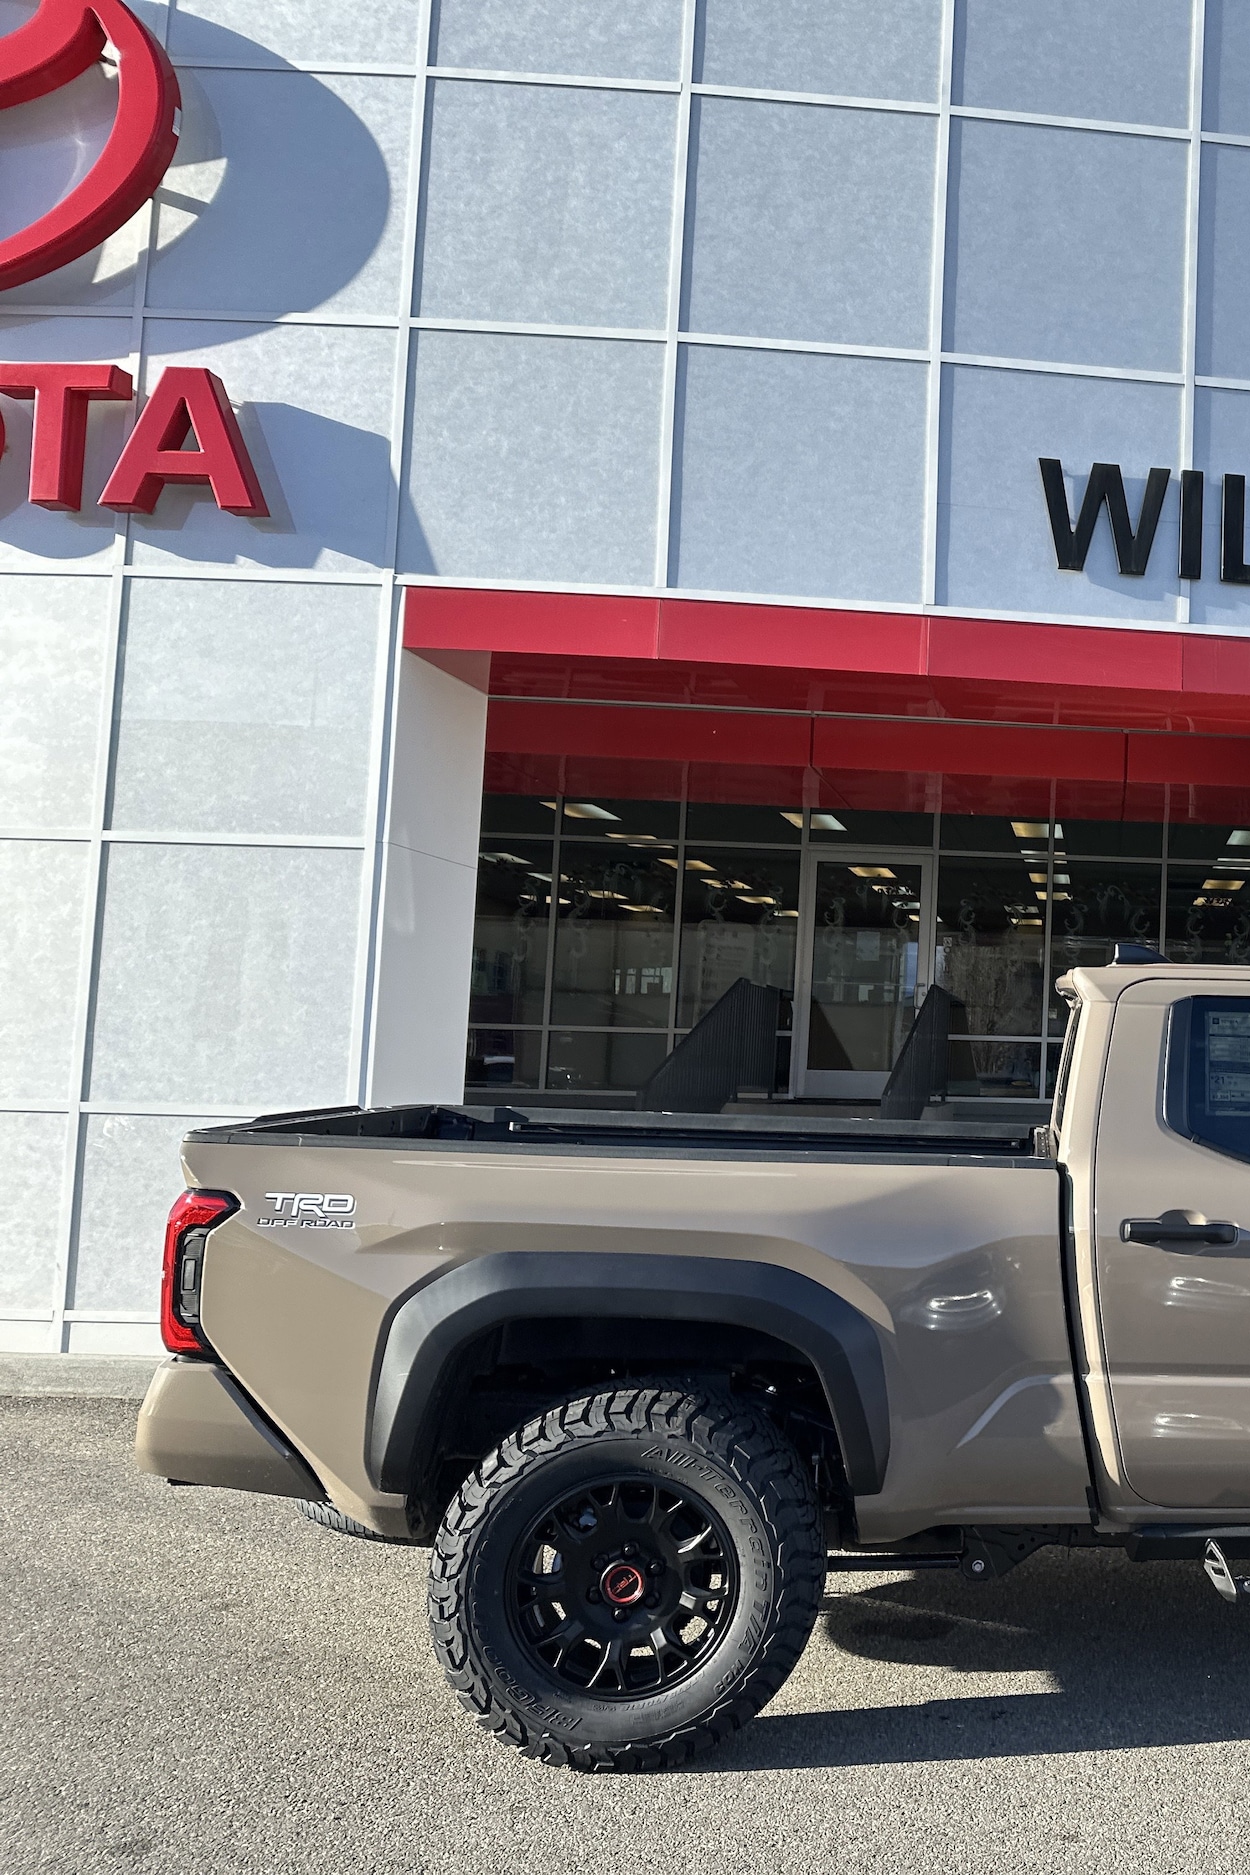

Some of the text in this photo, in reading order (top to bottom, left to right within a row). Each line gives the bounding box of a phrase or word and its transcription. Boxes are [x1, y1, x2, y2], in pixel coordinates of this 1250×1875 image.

[0, 364, 271, 517] TA
[265, 1192, 357, 1219] TRD
[257, 1217, 356, 1230] OFF ROAD
